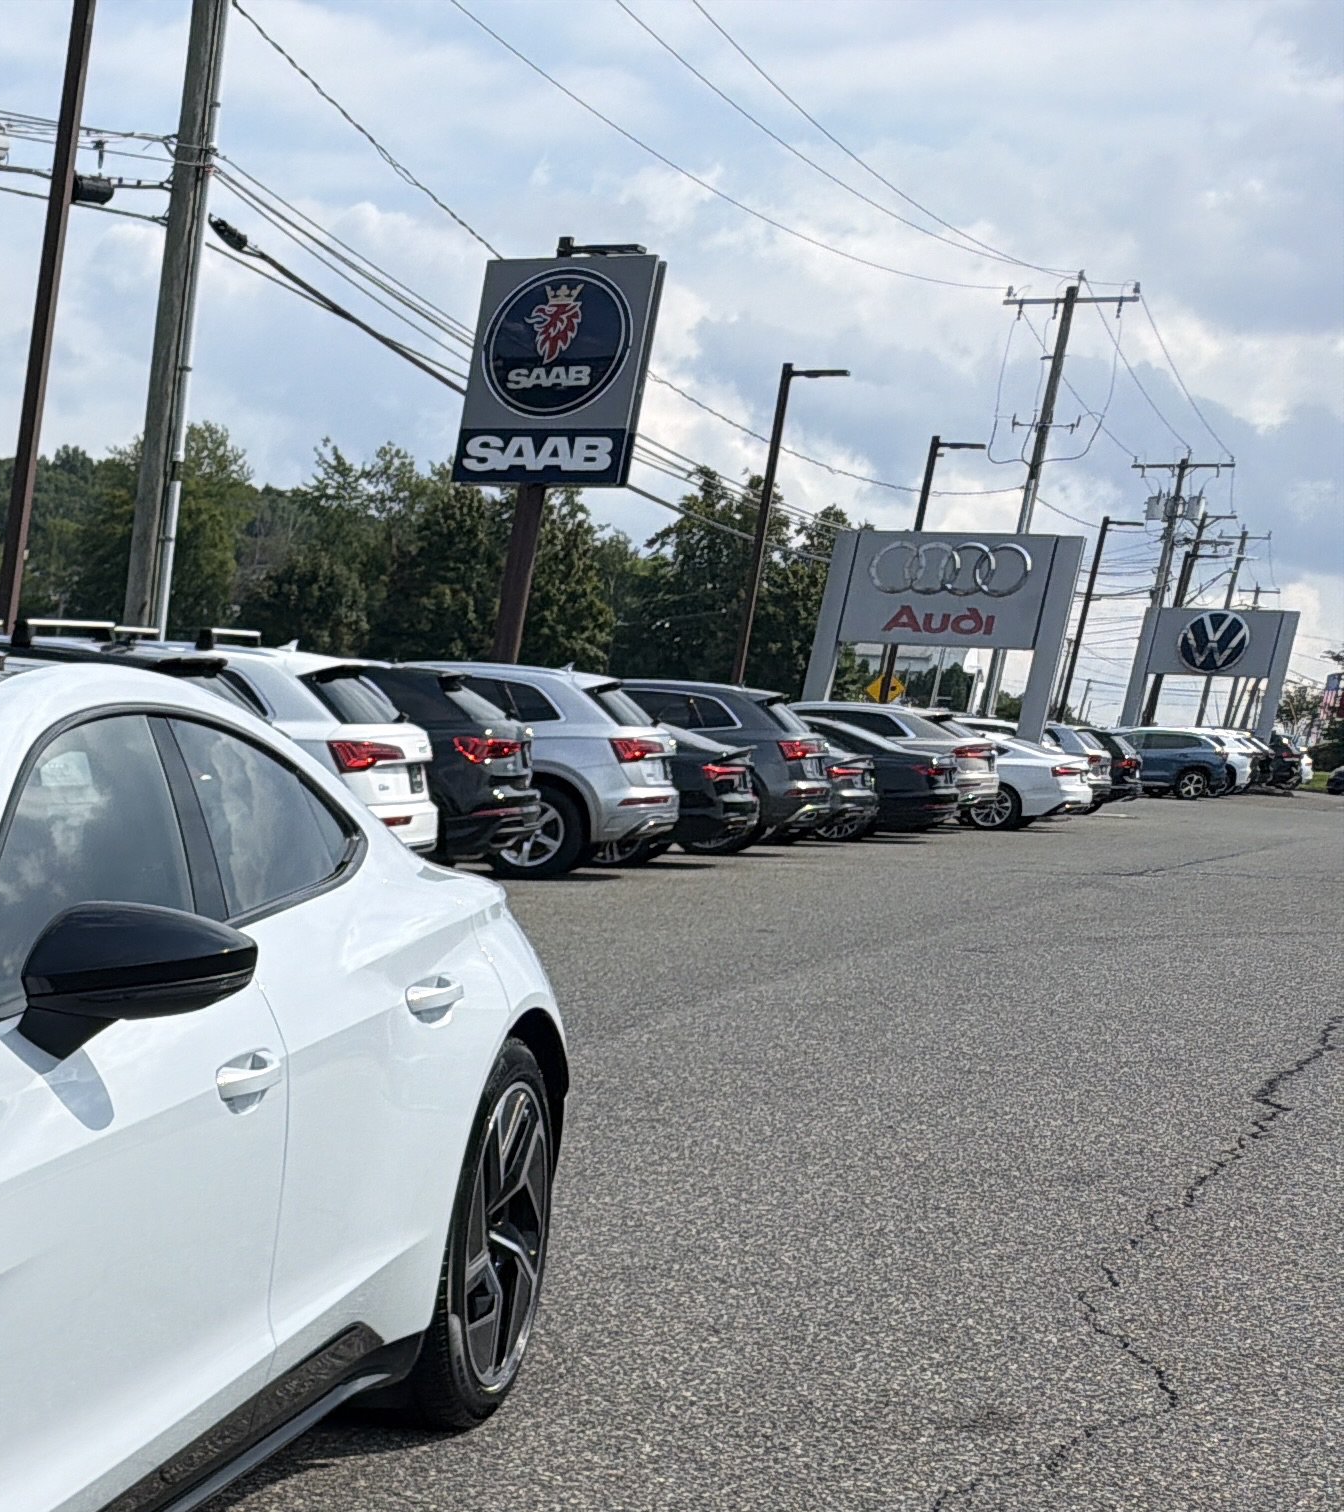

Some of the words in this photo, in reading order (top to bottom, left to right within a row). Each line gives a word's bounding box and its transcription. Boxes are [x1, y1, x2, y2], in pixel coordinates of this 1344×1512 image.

[507, 366, 591, 389] SAAB
[462, 435, 614, 472] SAAB
[881, 604, 996, 635] Audi
